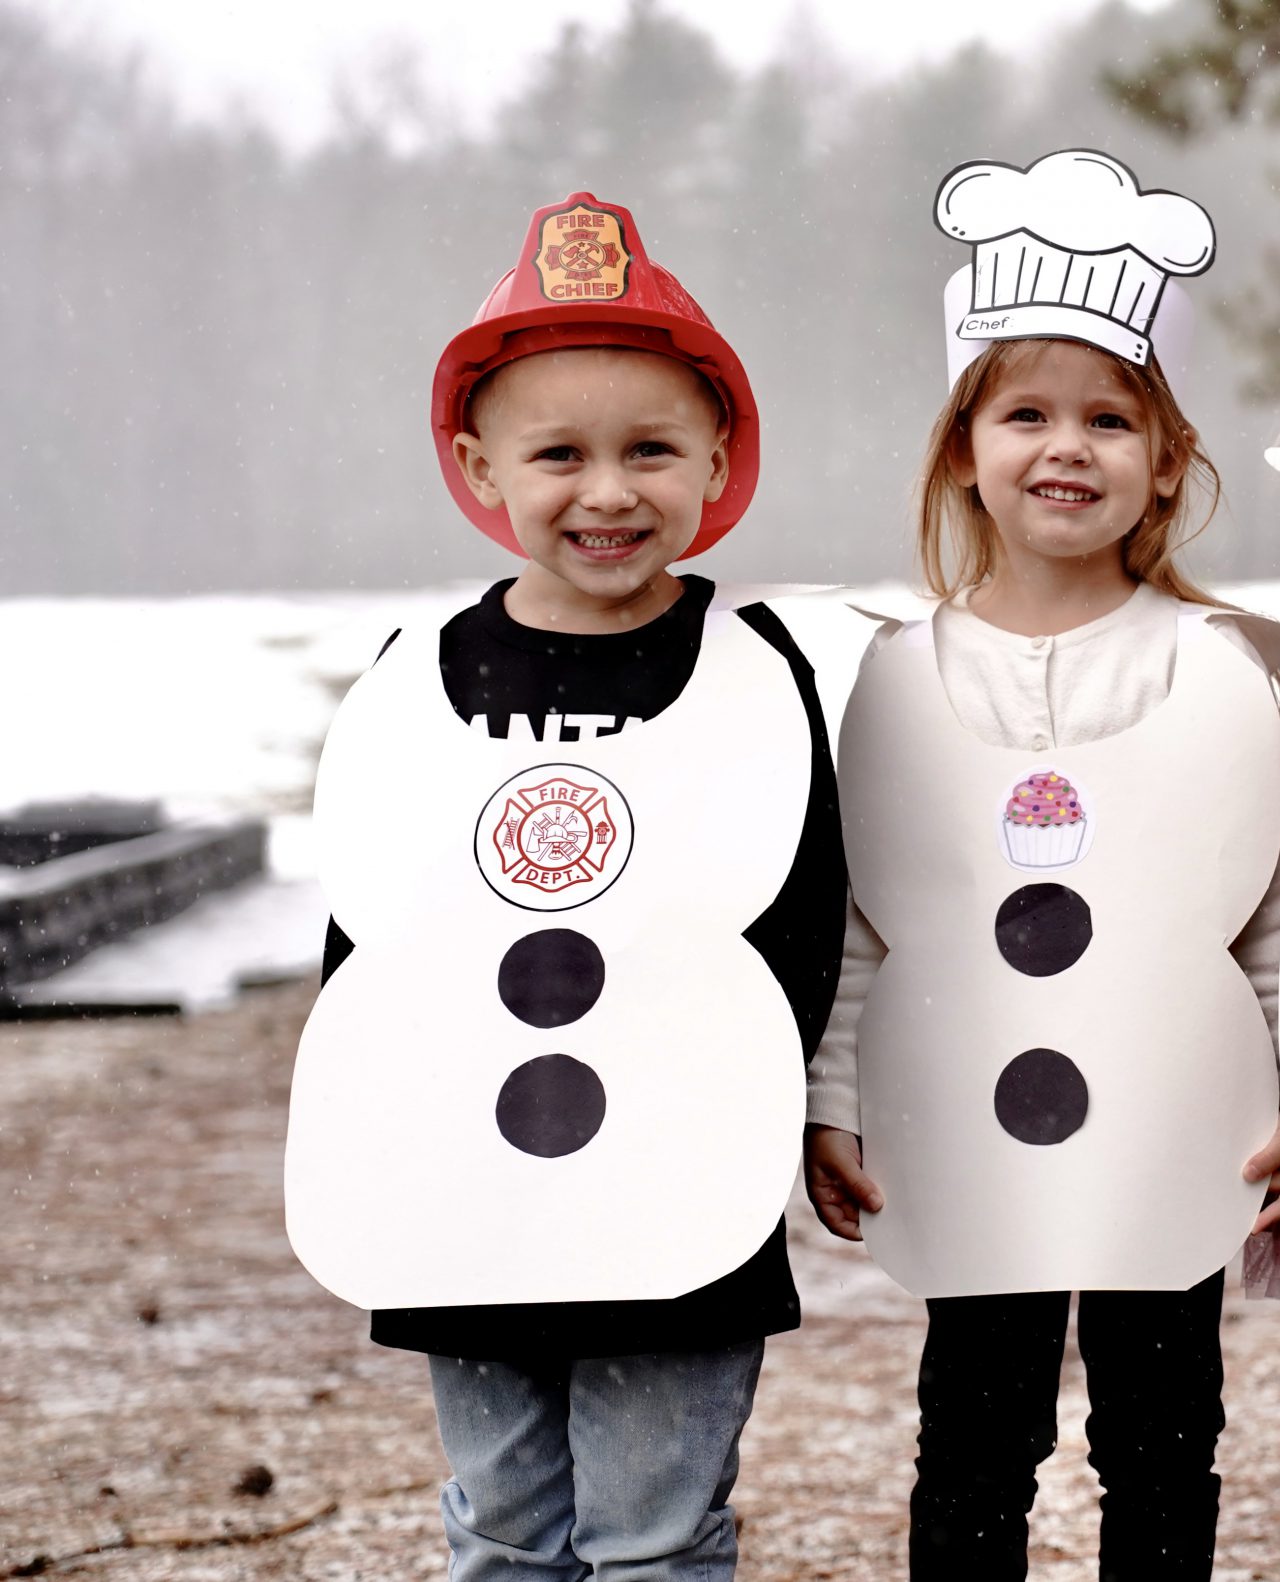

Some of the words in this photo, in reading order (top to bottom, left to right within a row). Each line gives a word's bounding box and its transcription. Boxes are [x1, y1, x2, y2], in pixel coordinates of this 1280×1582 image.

[556, 214, 605, 229] FIRE
[550, 283, 618, 298] CHIEF
[469, 713, 643, 742] NT
[539, 787, 581, 802] FIRE
[525, 868, 580, 884] DEPT.
